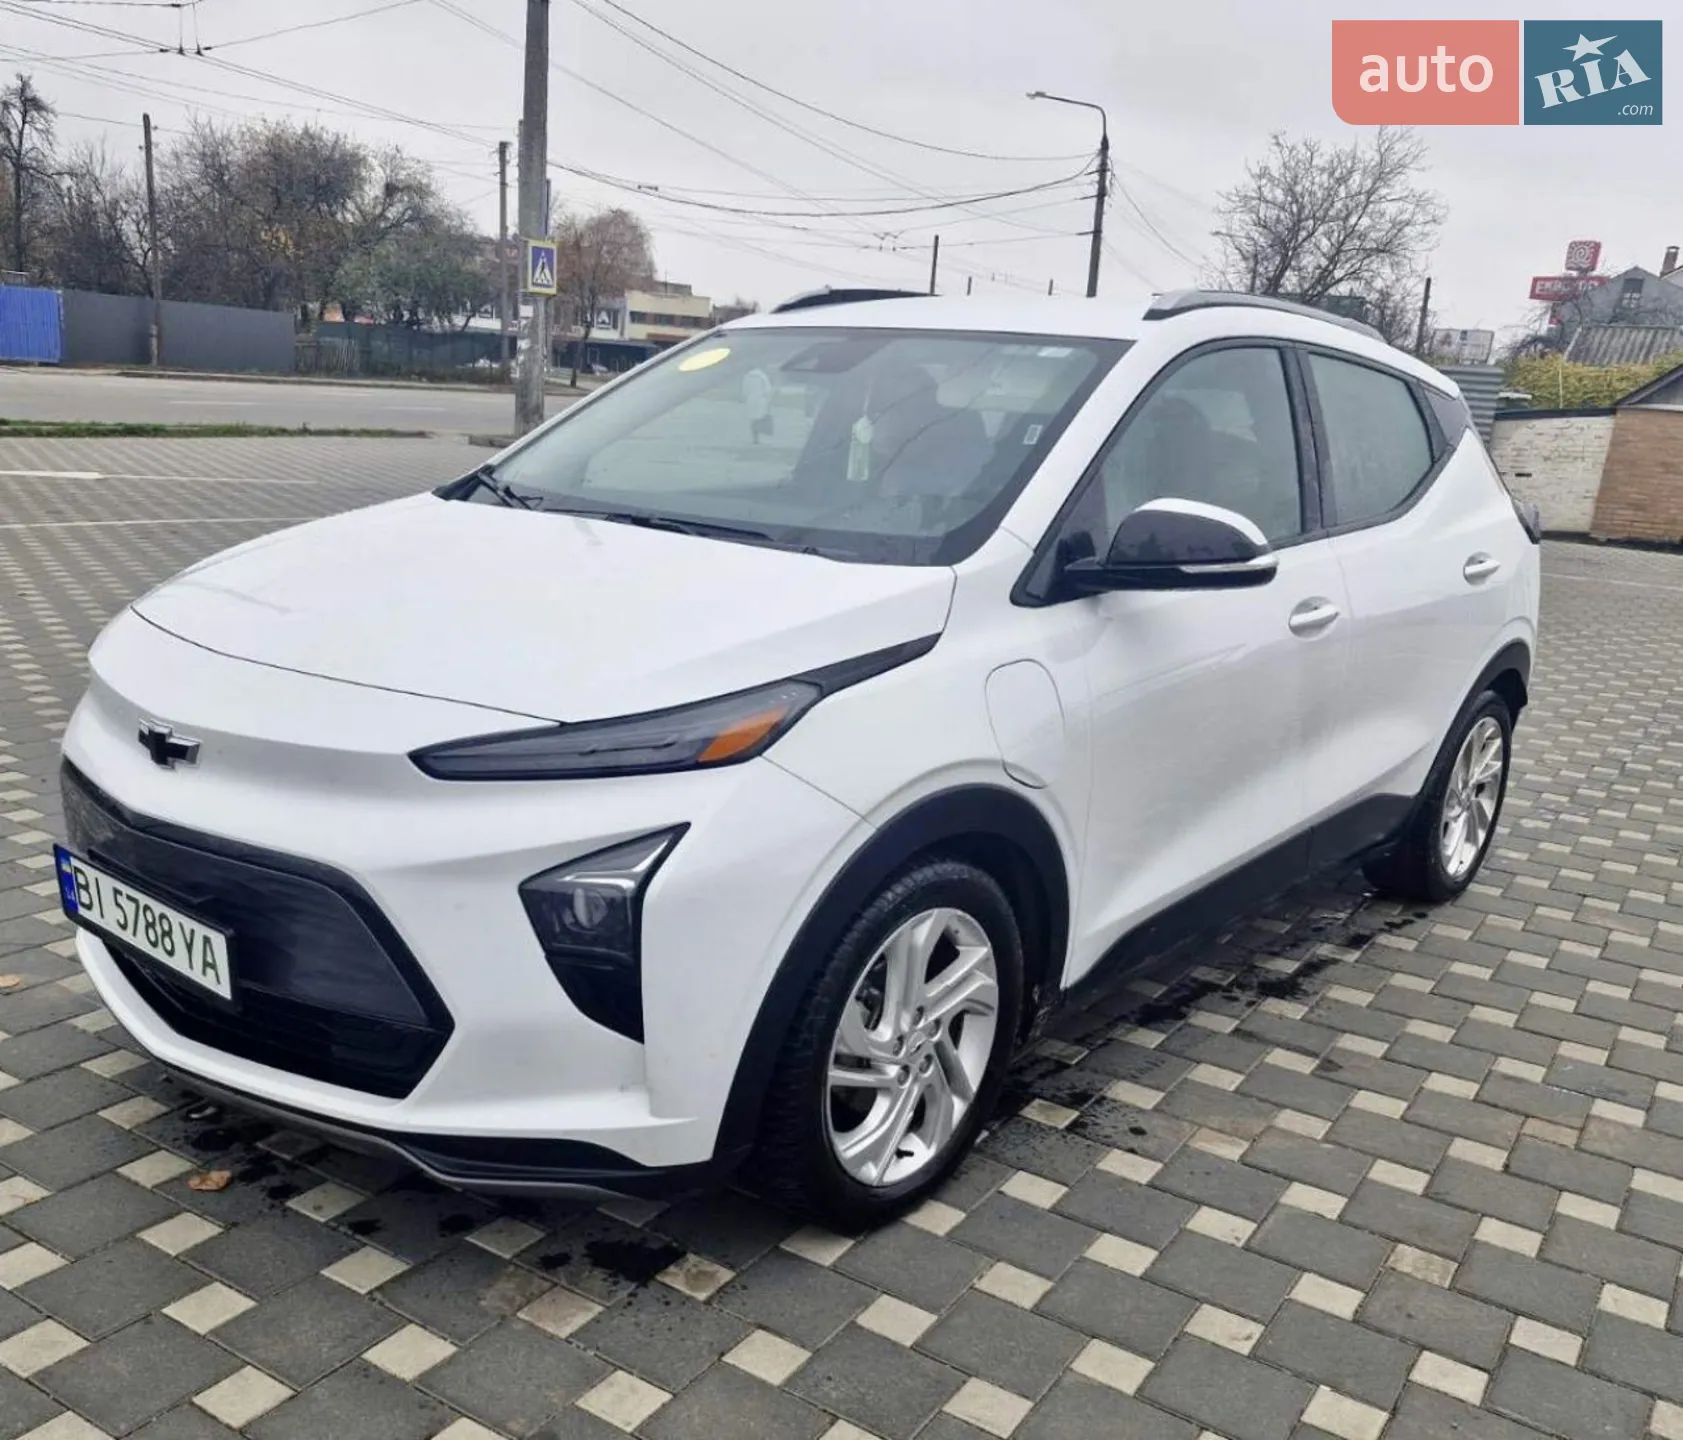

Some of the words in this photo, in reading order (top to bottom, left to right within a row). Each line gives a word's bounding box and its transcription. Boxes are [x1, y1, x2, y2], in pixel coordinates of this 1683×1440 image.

[74, 866, 105, 919] BI
[112, 886, 175, 958] 5788
[178, 920, 222, 985] YA
